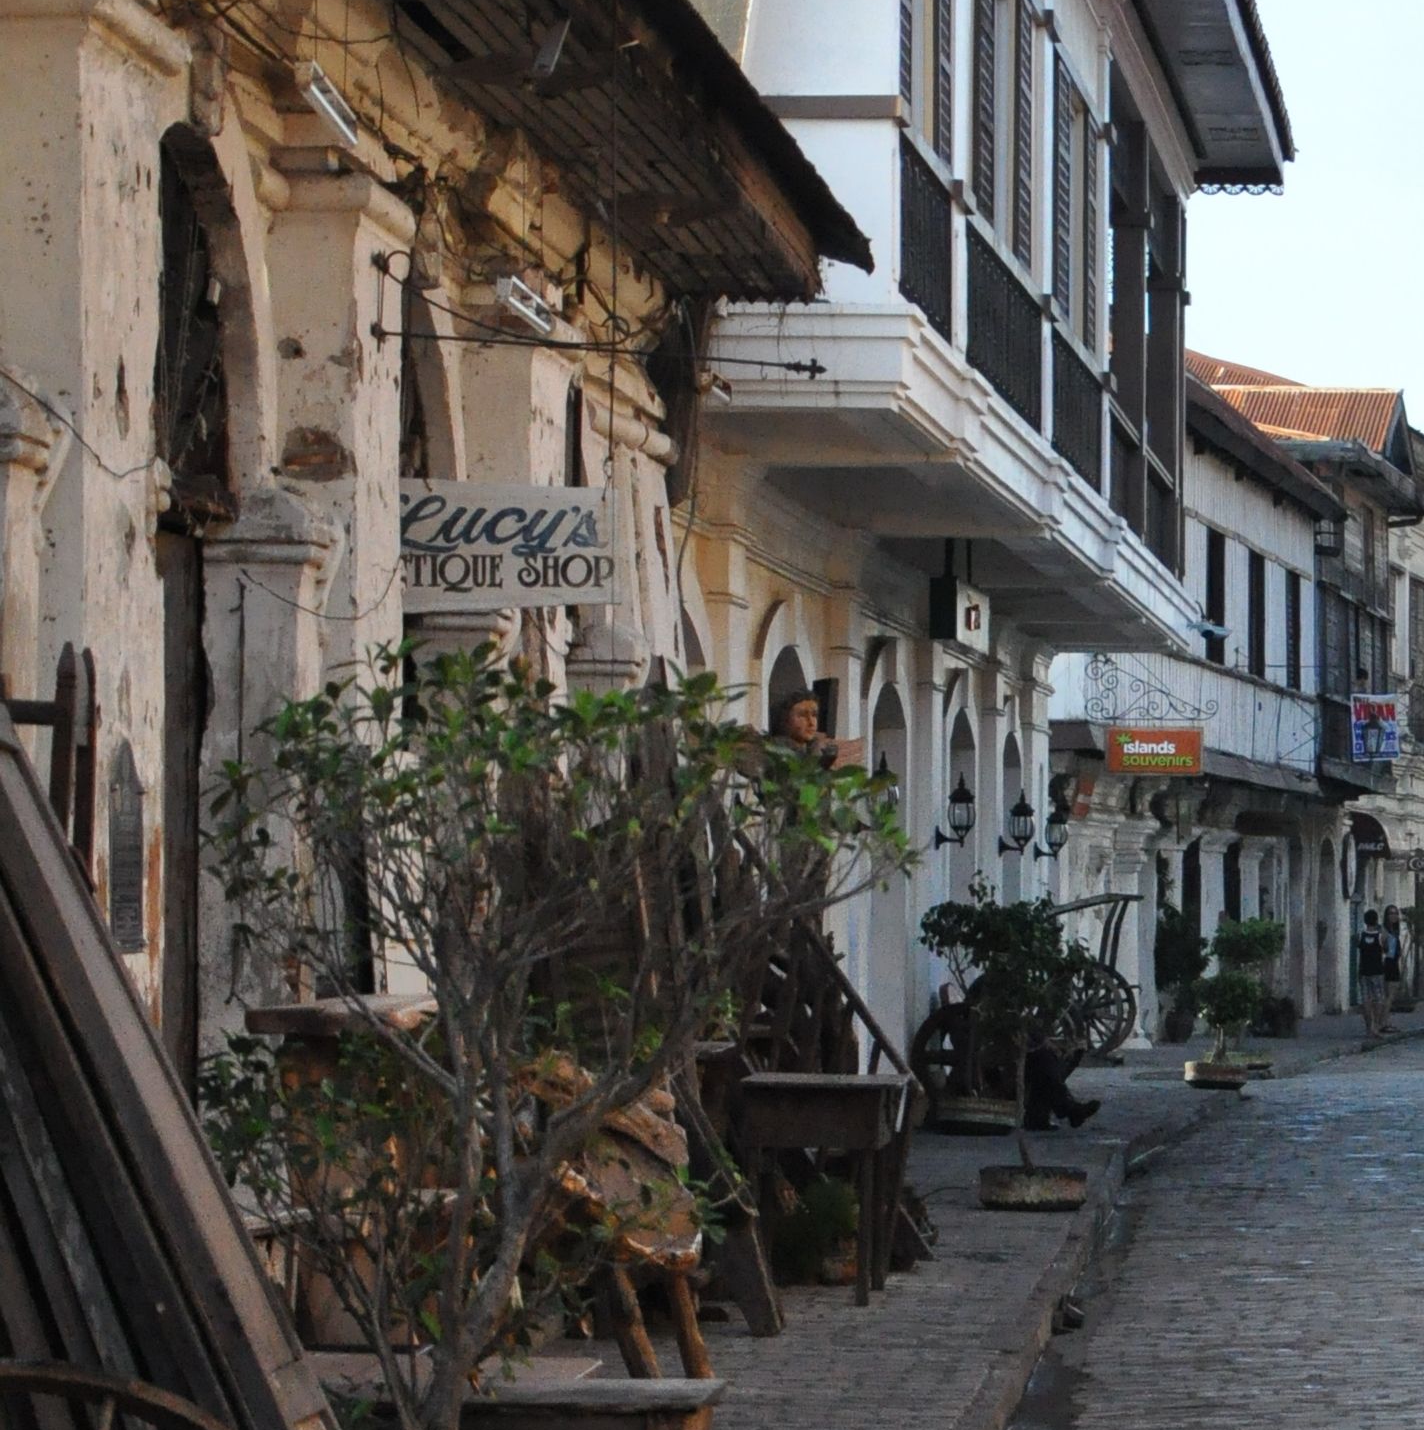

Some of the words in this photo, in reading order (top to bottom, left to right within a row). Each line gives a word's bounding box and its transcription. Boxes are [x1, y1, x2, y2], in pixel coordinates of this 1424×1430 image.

[401, 552, 504, 593] TIQUE
[517, 552, 616, 589] SHOP
[1123, 740, 1176, 754] islands
[1122, 755, 1194, 767] souvenirs
